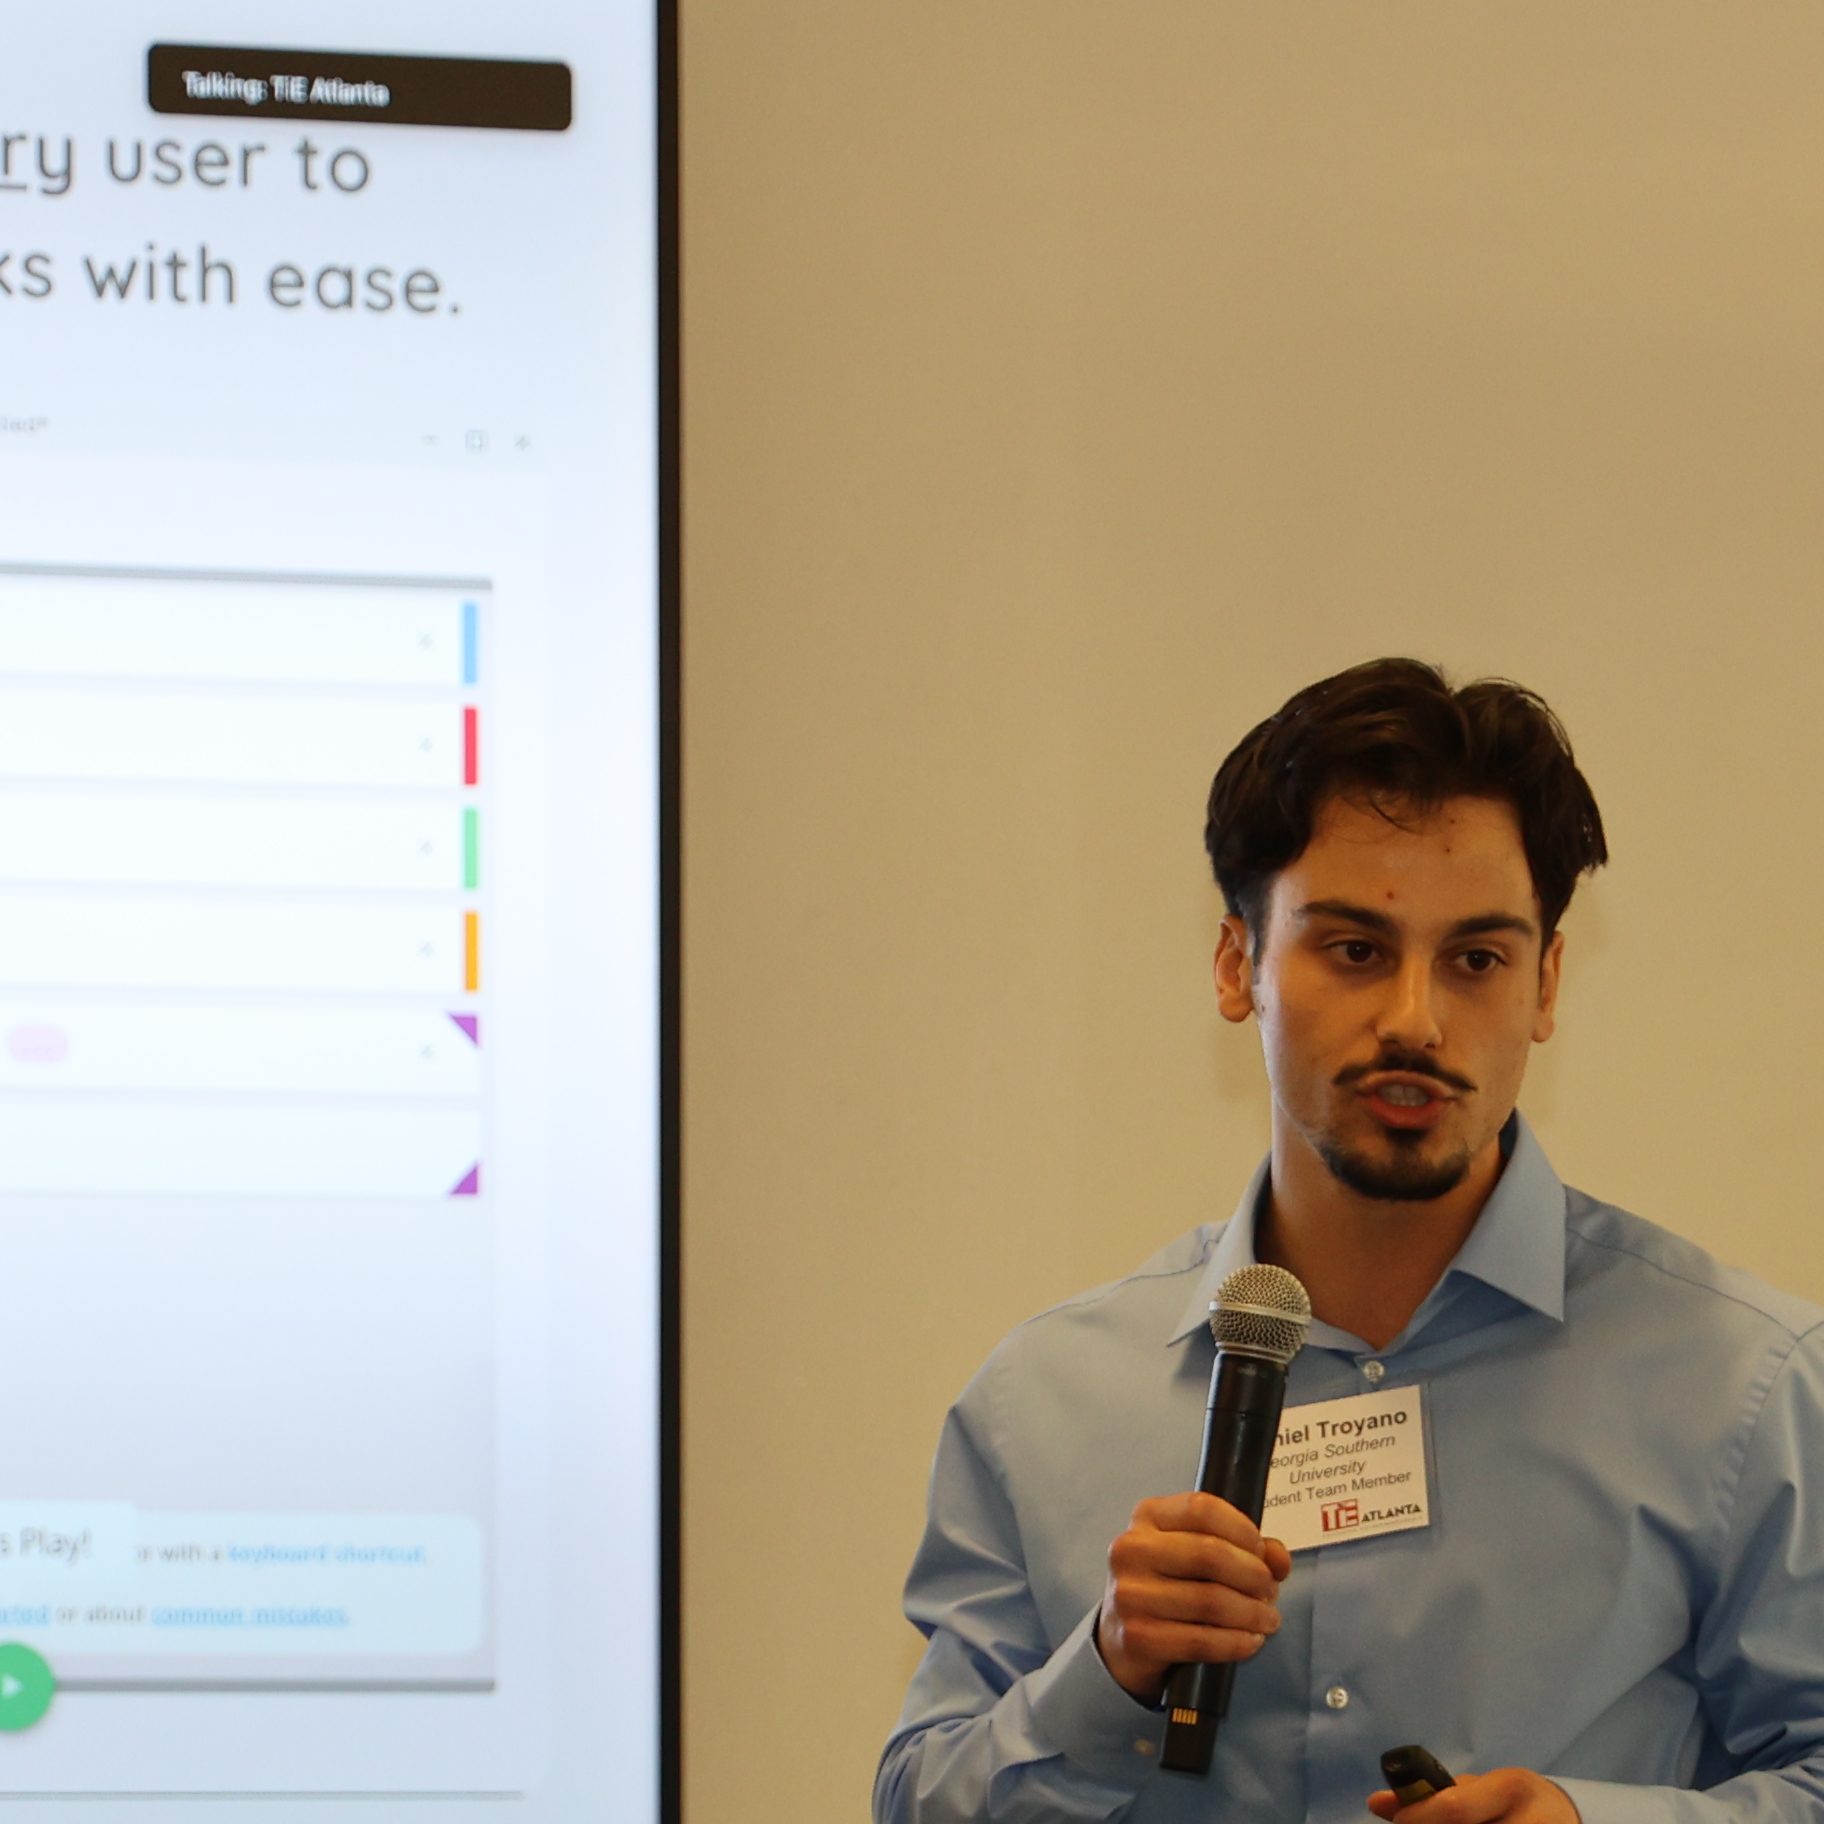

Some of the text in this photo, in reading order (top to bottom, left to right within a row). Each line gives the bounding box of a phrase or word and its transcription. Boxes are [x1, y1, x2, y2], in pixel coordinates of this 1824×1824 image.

[310, 76, 391, 108] Atlanta
[107, 134, 268, 190] user
[296, 136, 371, 193] to
[85, 243, 235, 306] with
[269, 262, 462, 316] ease.
[1316, 1411, 1407, 1438] Troyano
[1324, 1435, 1396, 1458] Southern
[1289, 1460, 1366, 1484] University
[1305, 1483, 1347, 1500] Team
[1351, 1471, 1412, 1490] Member
[1361, 1503, 1422, 1523] ATLANTA
[19, 1527, 92, 1565] Play!
